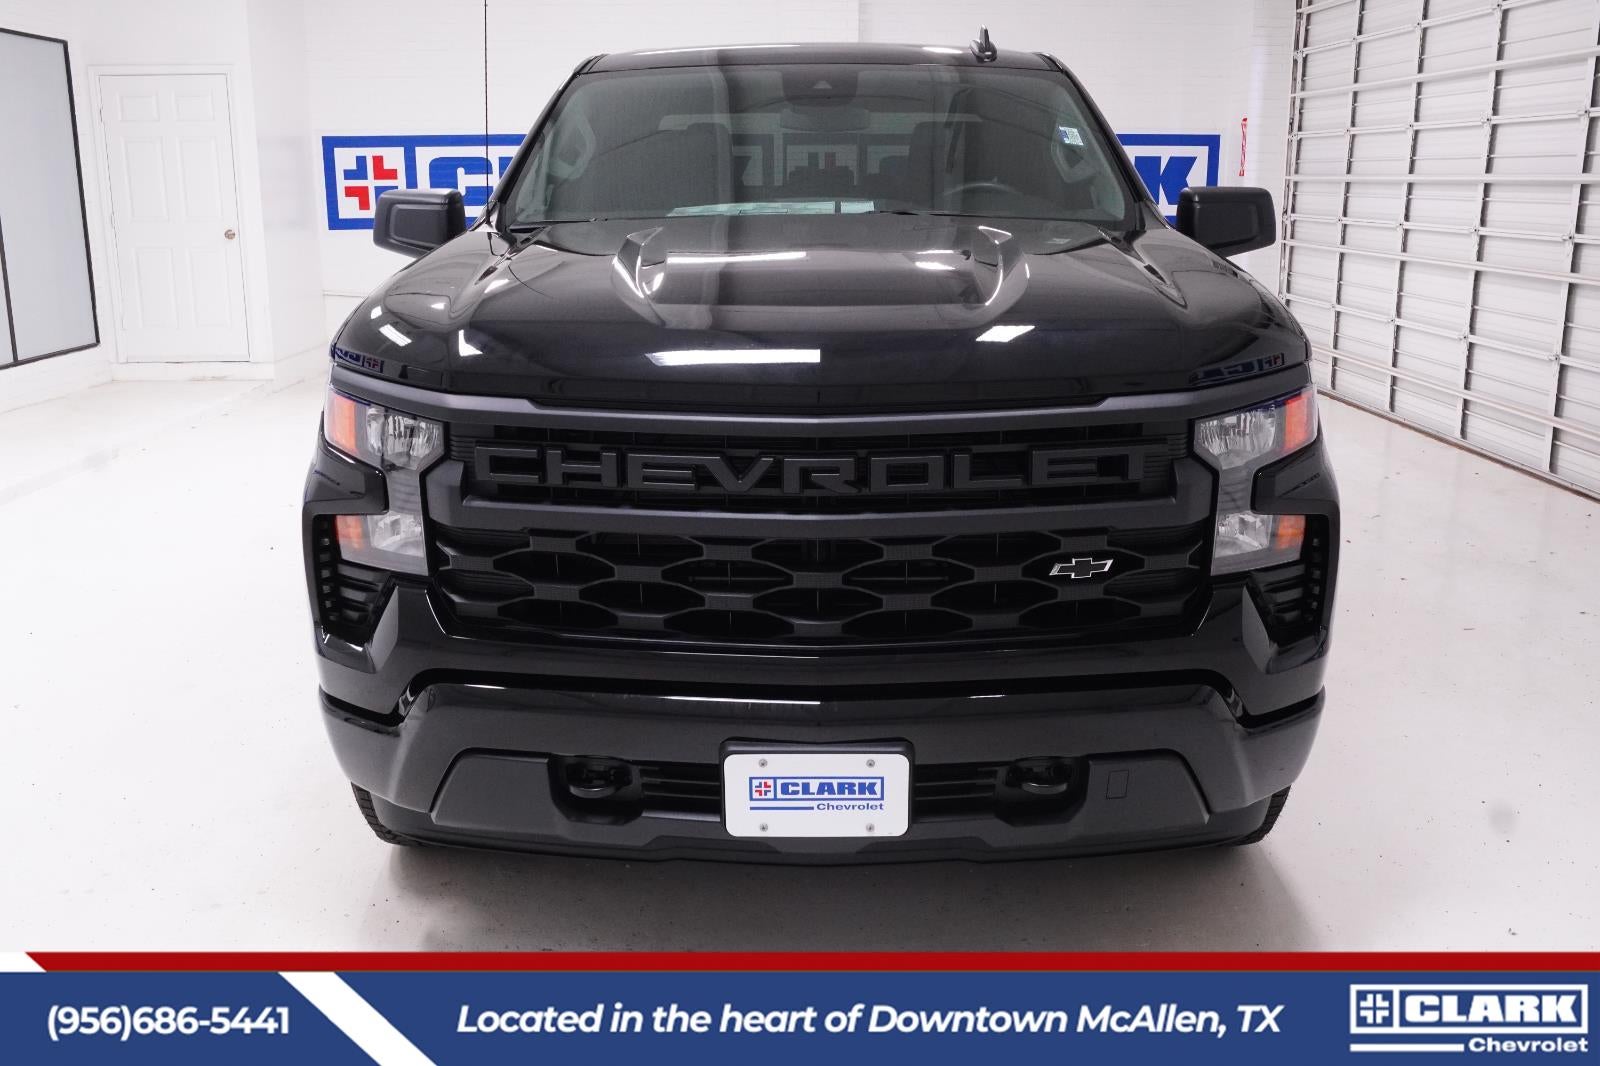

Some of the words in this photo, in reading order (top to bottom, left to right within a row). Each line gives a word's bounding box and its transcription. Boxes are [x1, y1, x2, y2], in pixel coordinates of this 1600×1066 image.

[474, 445, 1167, 493] CHEVROLET
[780, 782, 878, 796] CLARK
[816, 802, 884, 811] Chevrolet
